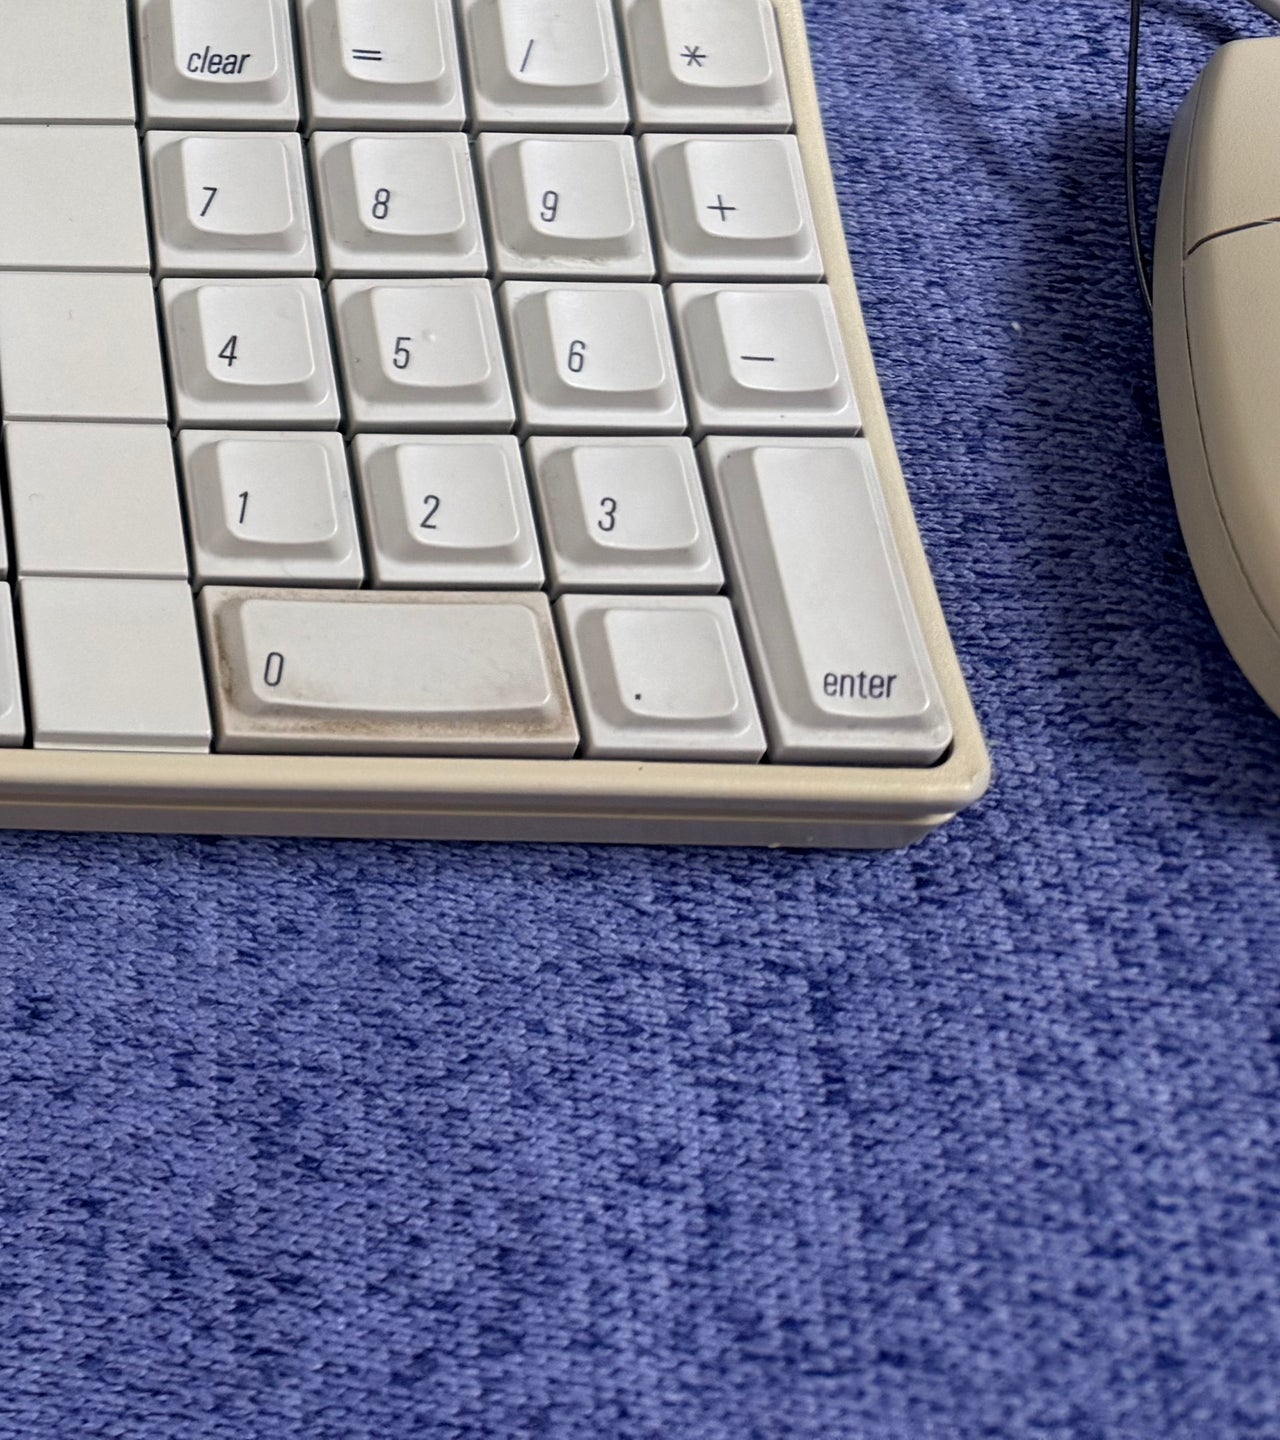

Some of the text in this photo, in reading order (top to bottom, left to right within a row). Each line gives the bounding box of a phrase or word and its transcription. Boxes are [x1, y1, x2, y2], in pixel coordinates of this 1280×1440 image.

[187, 46, 252, 75] clear
[519, 38, 535, 73] /
[200, 186, 218, 217] 7
[371, 187, 391, 220] 8
[540, 190, 559, 223] 9
[706, 194, 737, 222] +
[218, 335, 238, 367] 4
[392, 336, 412, 370] 5
[567, 339, 586, 373] 6
[420, 494, 441, 530] 2
[597, 496, 617, 532] 3
[263, 651, 285, 688] 0
[823, 671, 898, 700] enter
